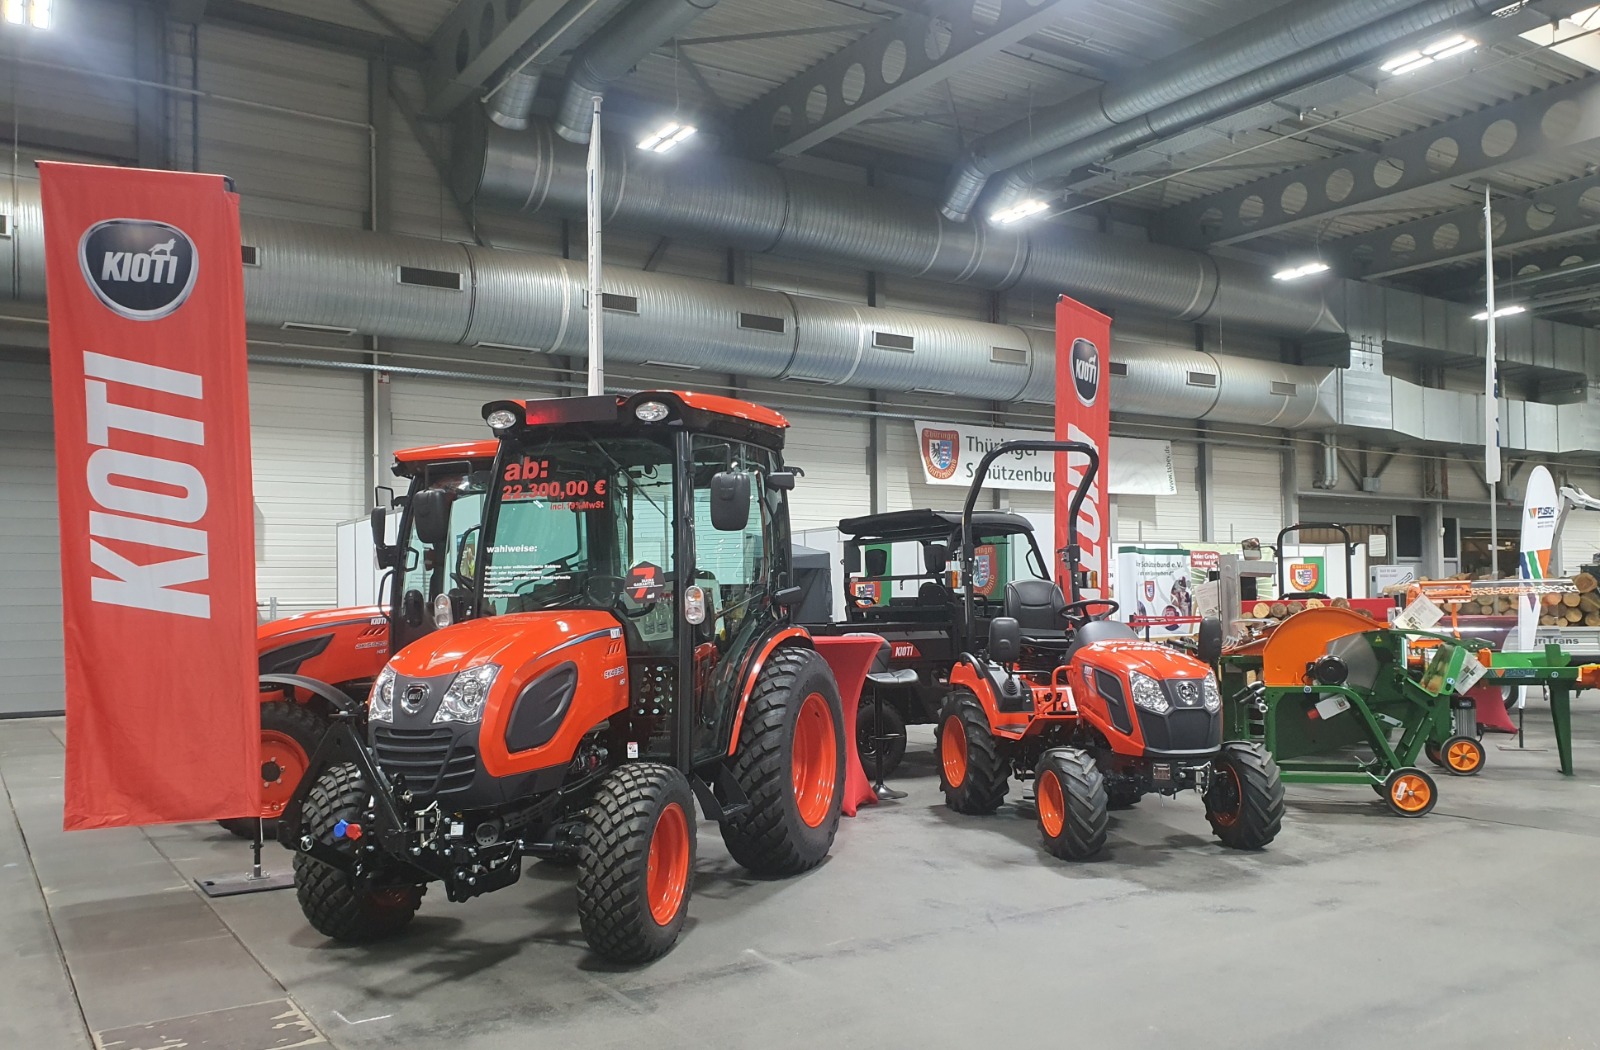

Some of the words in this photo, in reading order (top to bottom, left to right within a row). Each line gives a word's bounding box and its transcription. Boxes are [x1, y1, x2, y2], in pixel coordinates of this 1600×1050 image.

[101, 251, 178, 284] KIOTI
[1076, 359, 1096, 384] KIOTI
[966, 436, 1037, 460] Thürger
[504, 456, 548, 481] ab:
[966, 463, 1055, 482] Shützenbu
[83, 350, 210, 619] KIOTI
[502, 480, 588, 500] 22.300,00
[594, 480, 606, 495] €
[486, 544, 538, 553] wahlweise:
[633, 567, 655, 599] 7
[895, 645, 914, 657] KIOTI
[1533, 635, 1579, 646] griTrans
